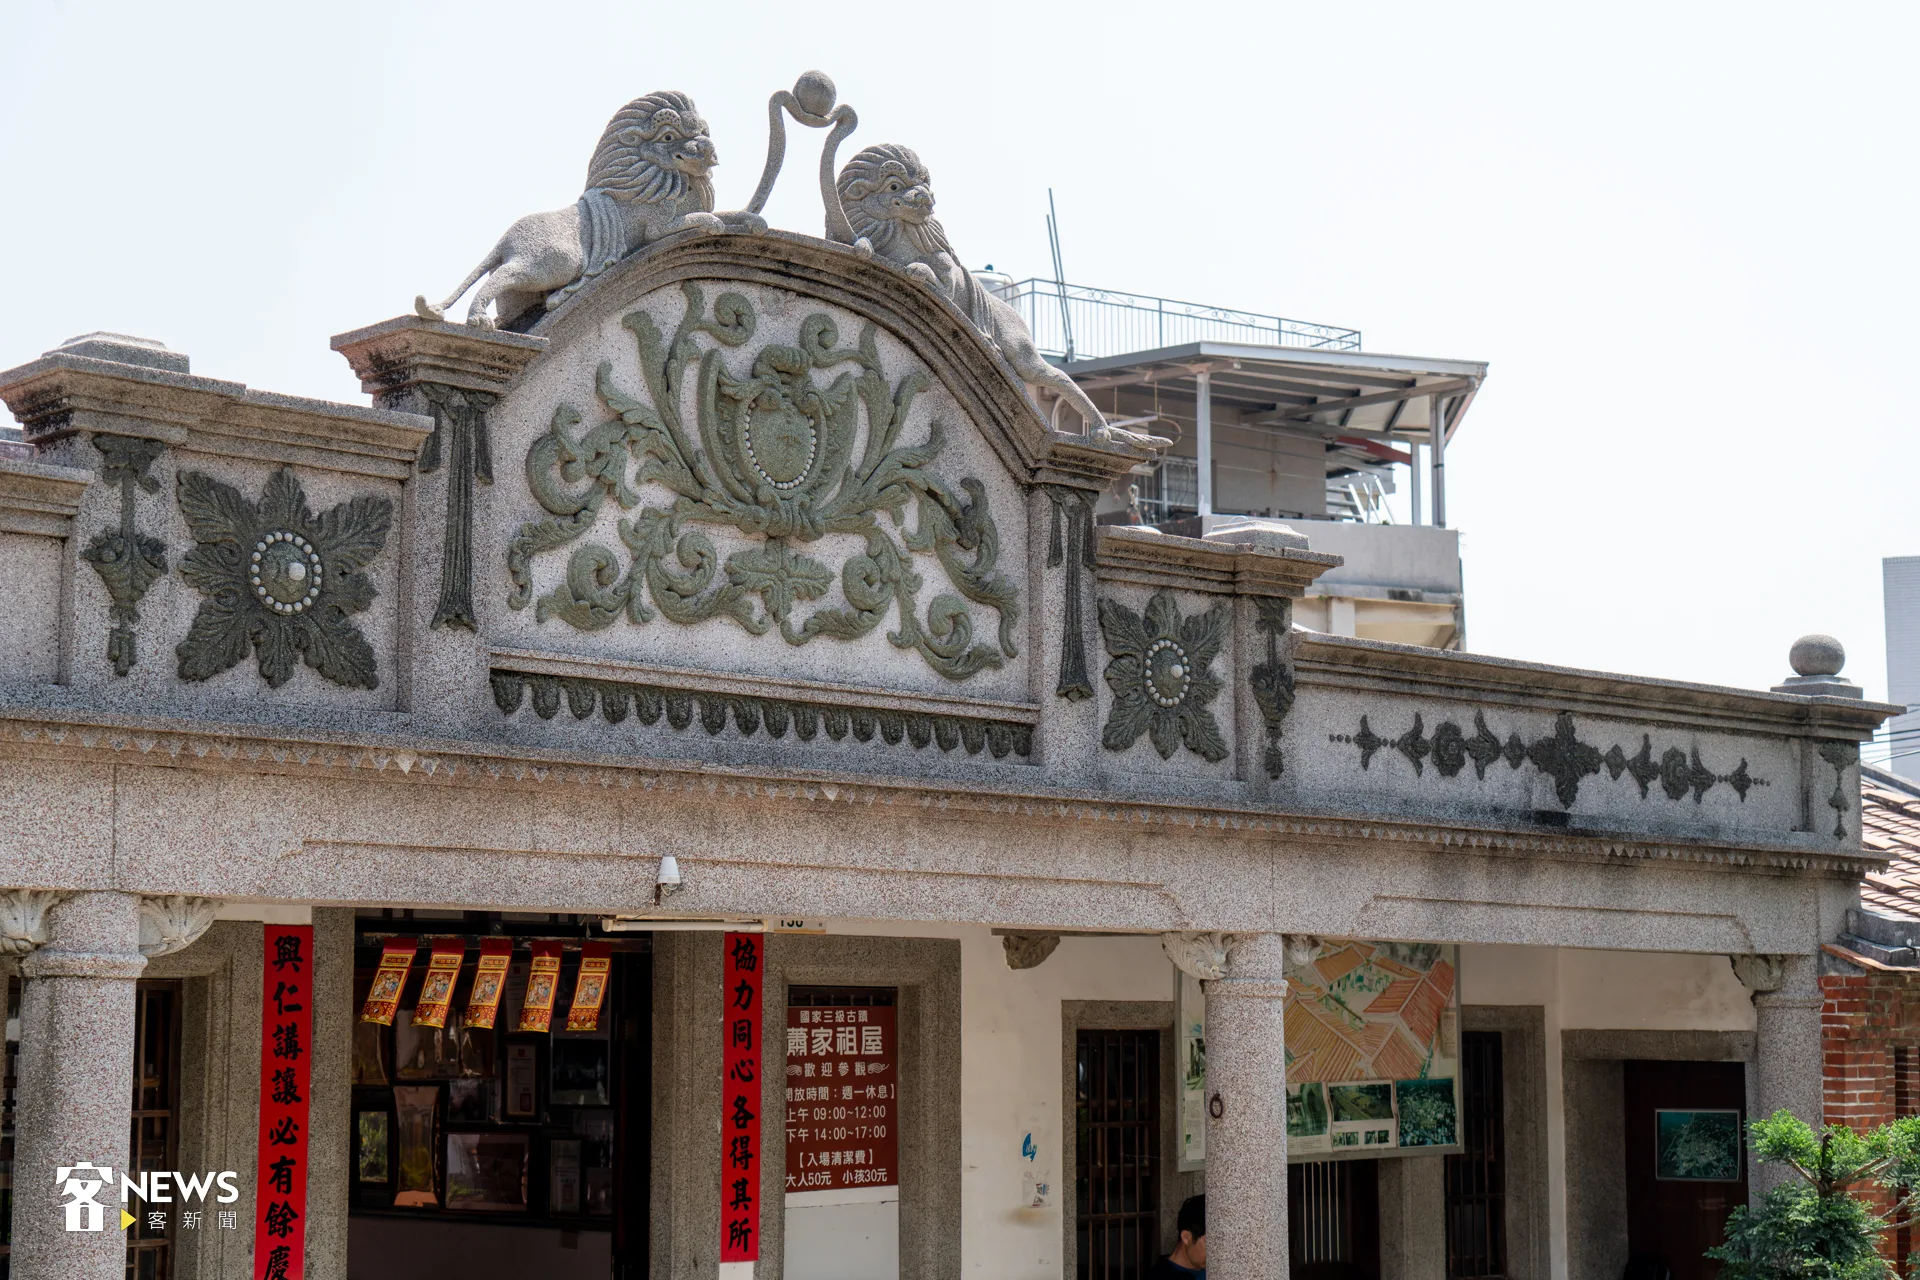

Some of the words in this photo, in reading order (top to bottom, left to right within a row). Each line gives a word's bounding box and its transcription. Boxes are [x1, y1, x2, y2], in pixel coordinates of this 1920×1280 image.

[800, 1010, 868, 1023] 國家三級古蹟
[787, 1026, 883, 1056] 蕭家祖屋
[804, 1062, 866, 1077] 歡迎參觀
[728, 938, 757, 1253] 協力同心各得其所
[786, 1108, 808, 1122] 上午
[813, 1105, 886, 1120] 09:00~12:00
[786, 1128, 808, 1143] 下午
[814, 1125, 886, 1140] 14:00~17:00
[786, 1171, 832, 1188] 大人50元
[842, 1168, 887, 1184] 小孩30元
